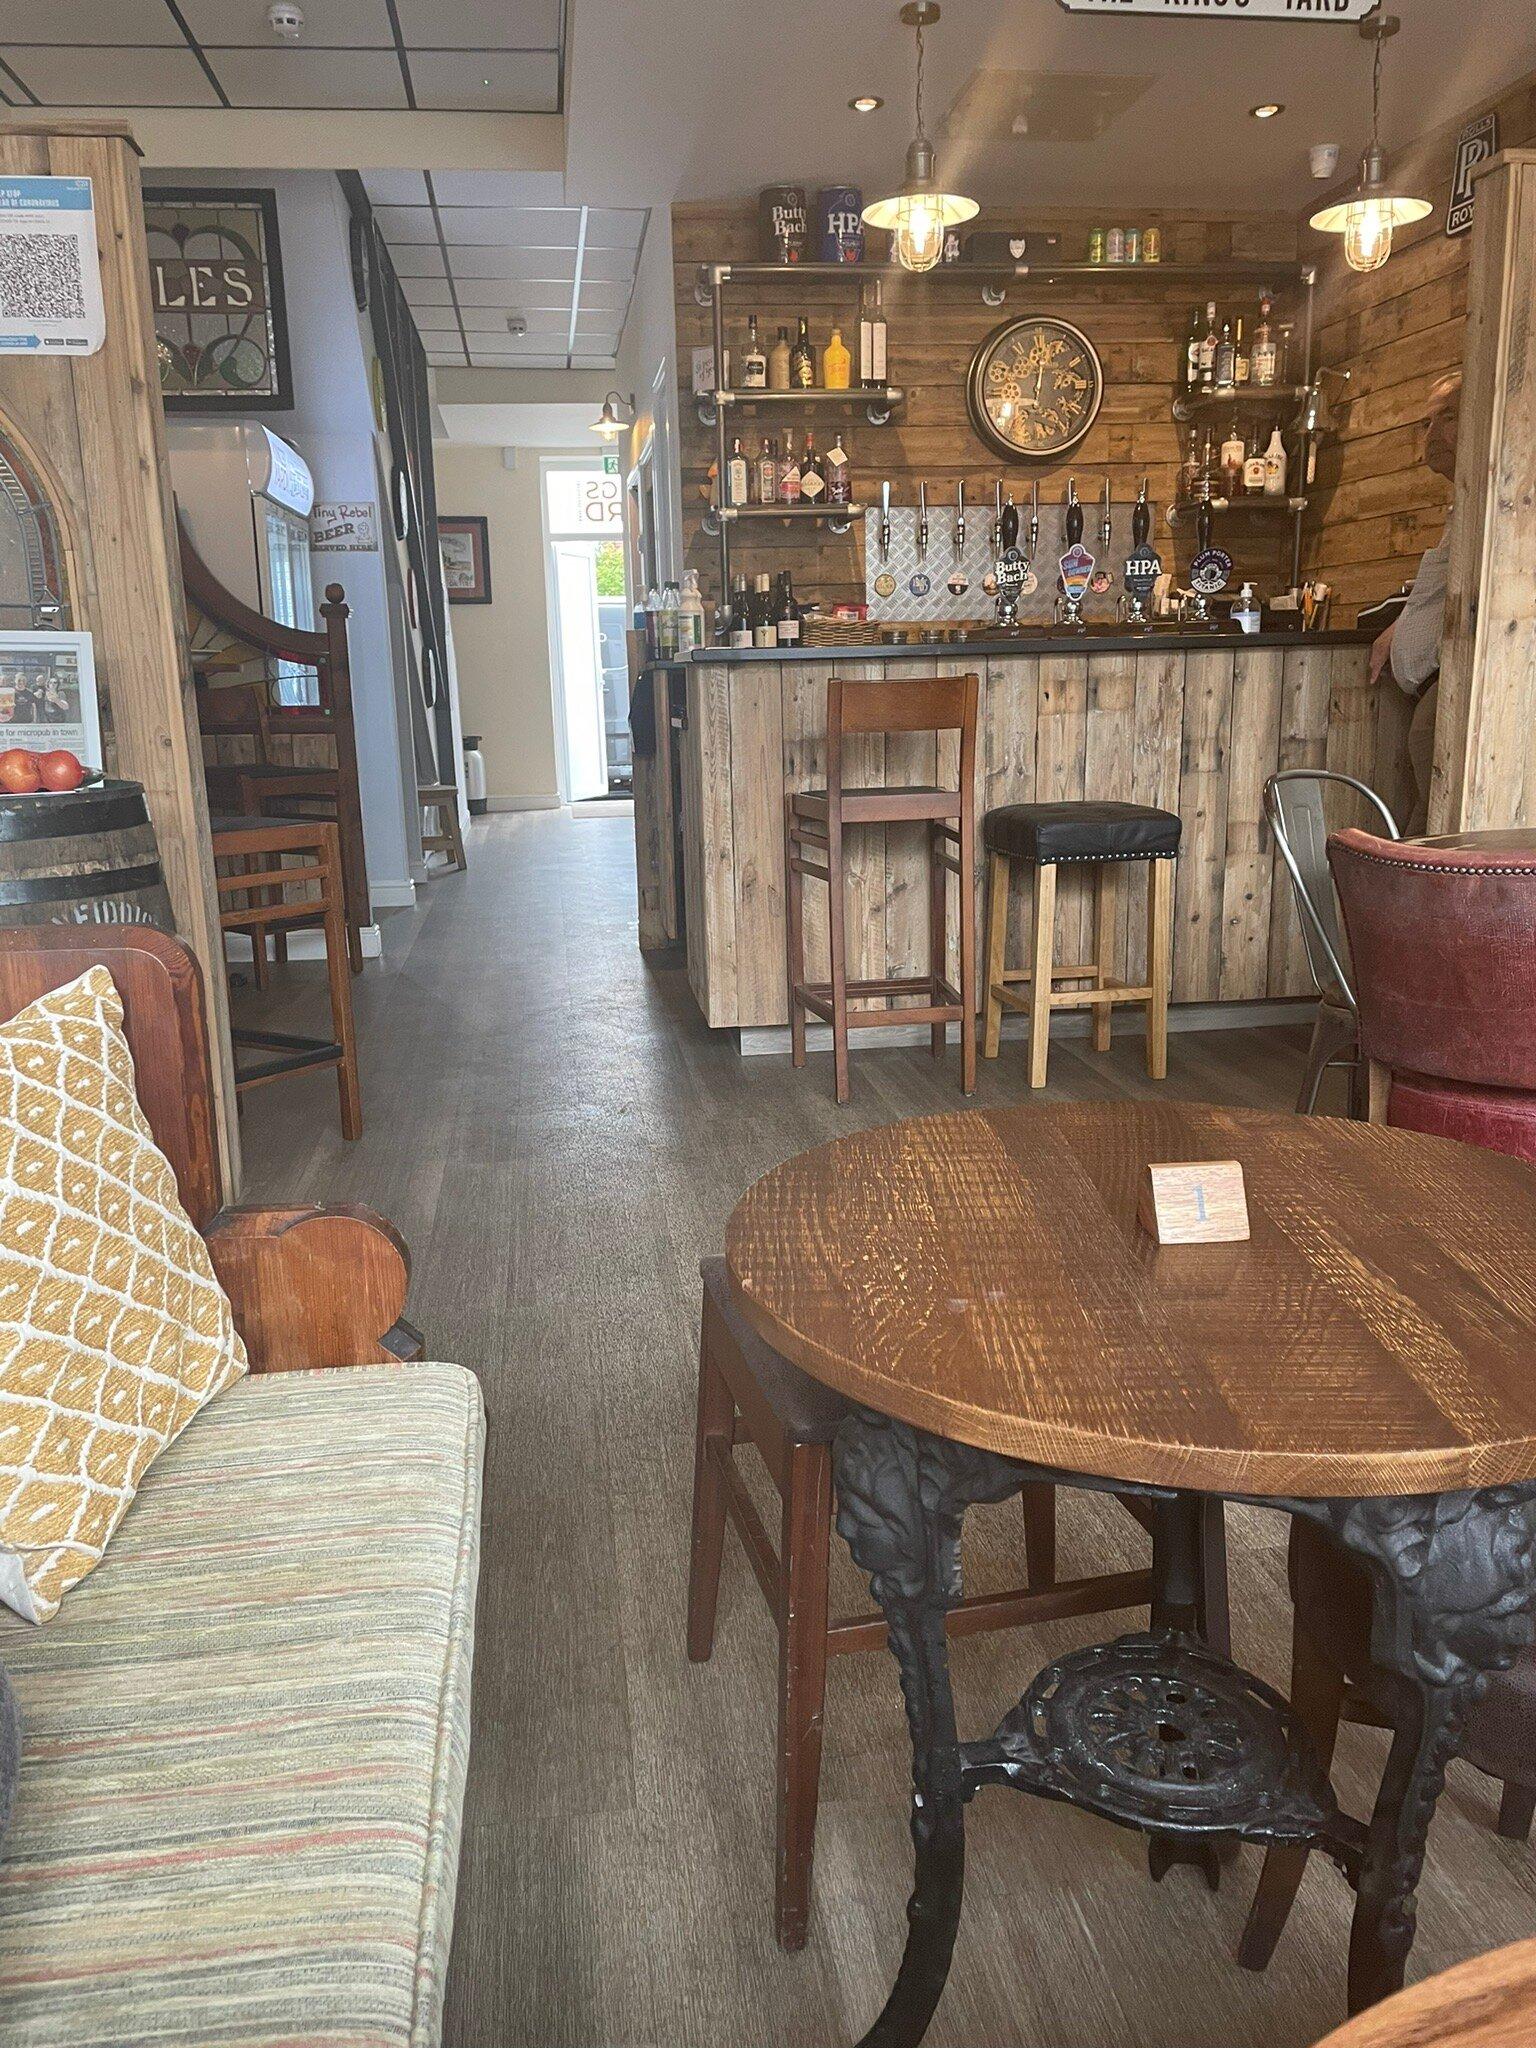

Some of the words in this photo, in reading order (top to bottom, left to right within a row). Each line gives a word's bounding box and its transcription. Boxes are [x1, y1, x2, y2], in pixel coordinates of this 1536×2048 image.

[313, 505, 337, 525] Tiny
[338, 504, 372, 520] Rebel
[313, 523, 356, 543] BEER
[995, 561, 1030, 572] Butty
[1193, 551, 1211, 567] PLUM
[1125, 559, 1163, 576] HPA
[995, 570, 1029, 585] Bach
[1194, 580, 1225, 591] TITANIC
[1193, 1184, 1208, 1223] 1
